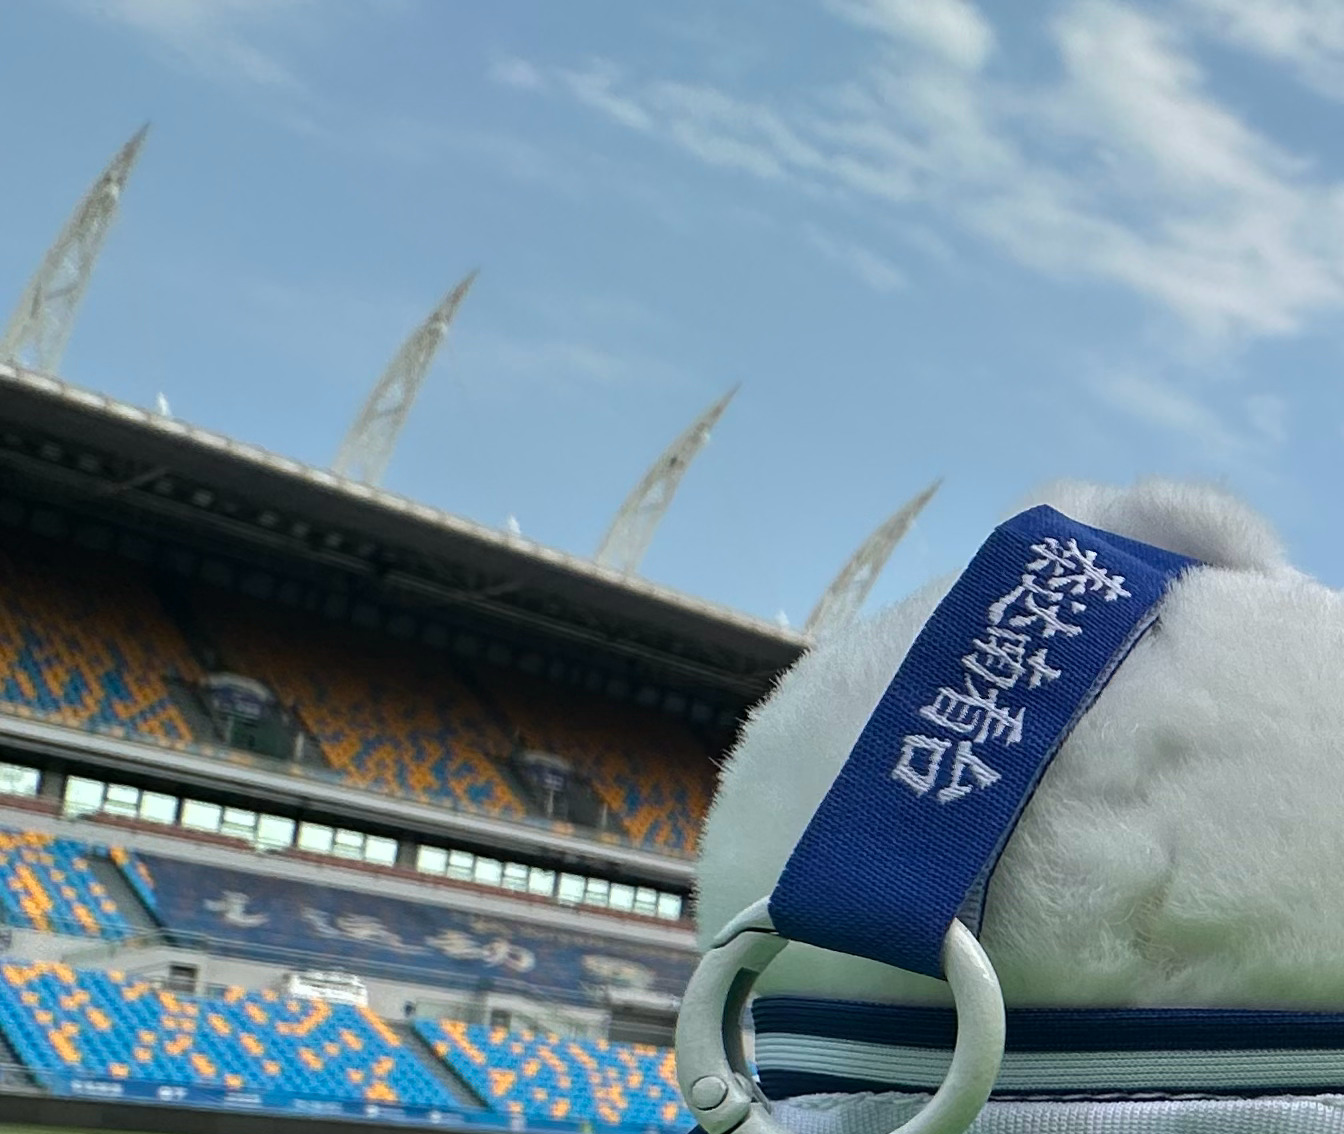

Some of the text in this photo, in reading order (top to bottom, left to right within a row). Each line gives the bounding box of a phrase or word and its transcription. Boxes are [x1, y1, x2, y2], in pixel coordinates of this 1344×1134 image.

[893, 537, 1132, 803] 泰达南看台
